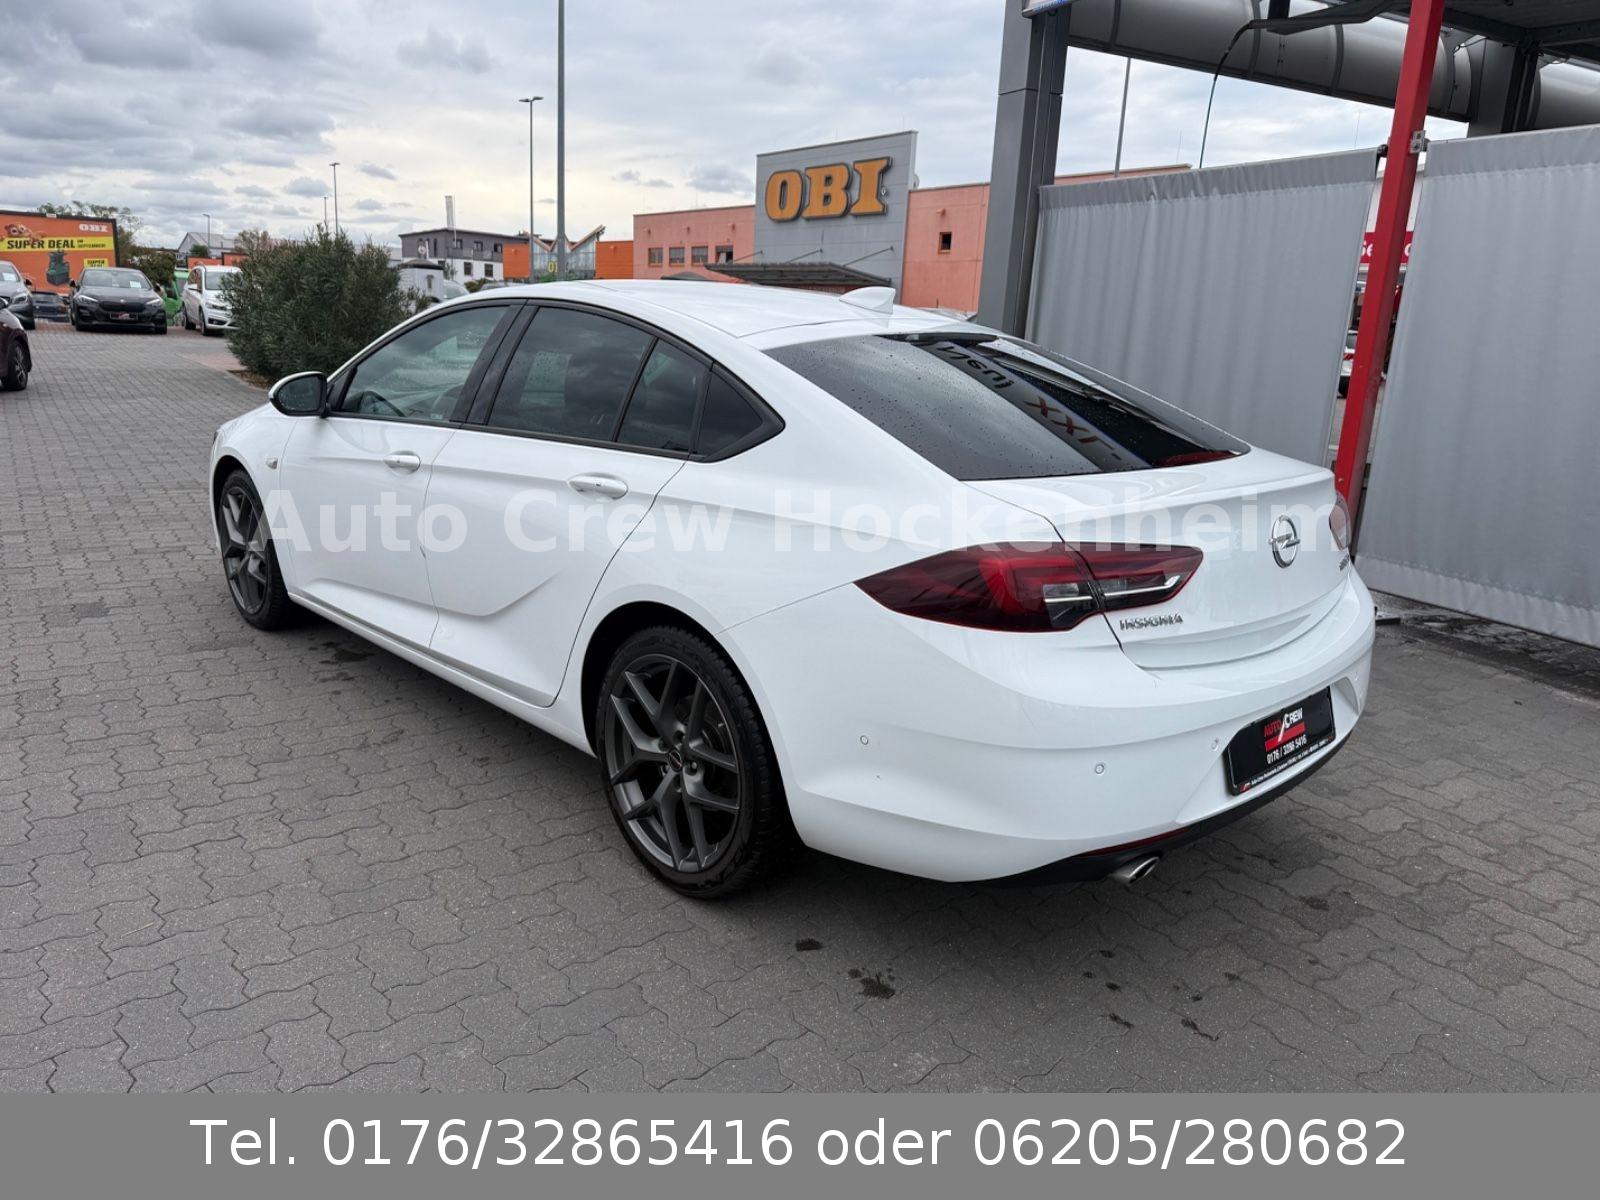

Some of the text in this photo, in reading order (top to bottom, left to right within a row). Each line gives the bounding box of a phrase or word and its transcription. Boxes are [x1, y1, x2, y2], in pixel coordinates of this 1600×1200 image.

[764, 156, 892, 222] OBI
[7, 239, 75, 249] SUPER DEAL
[1120, 613, 1183, 631] INSIGNIA
